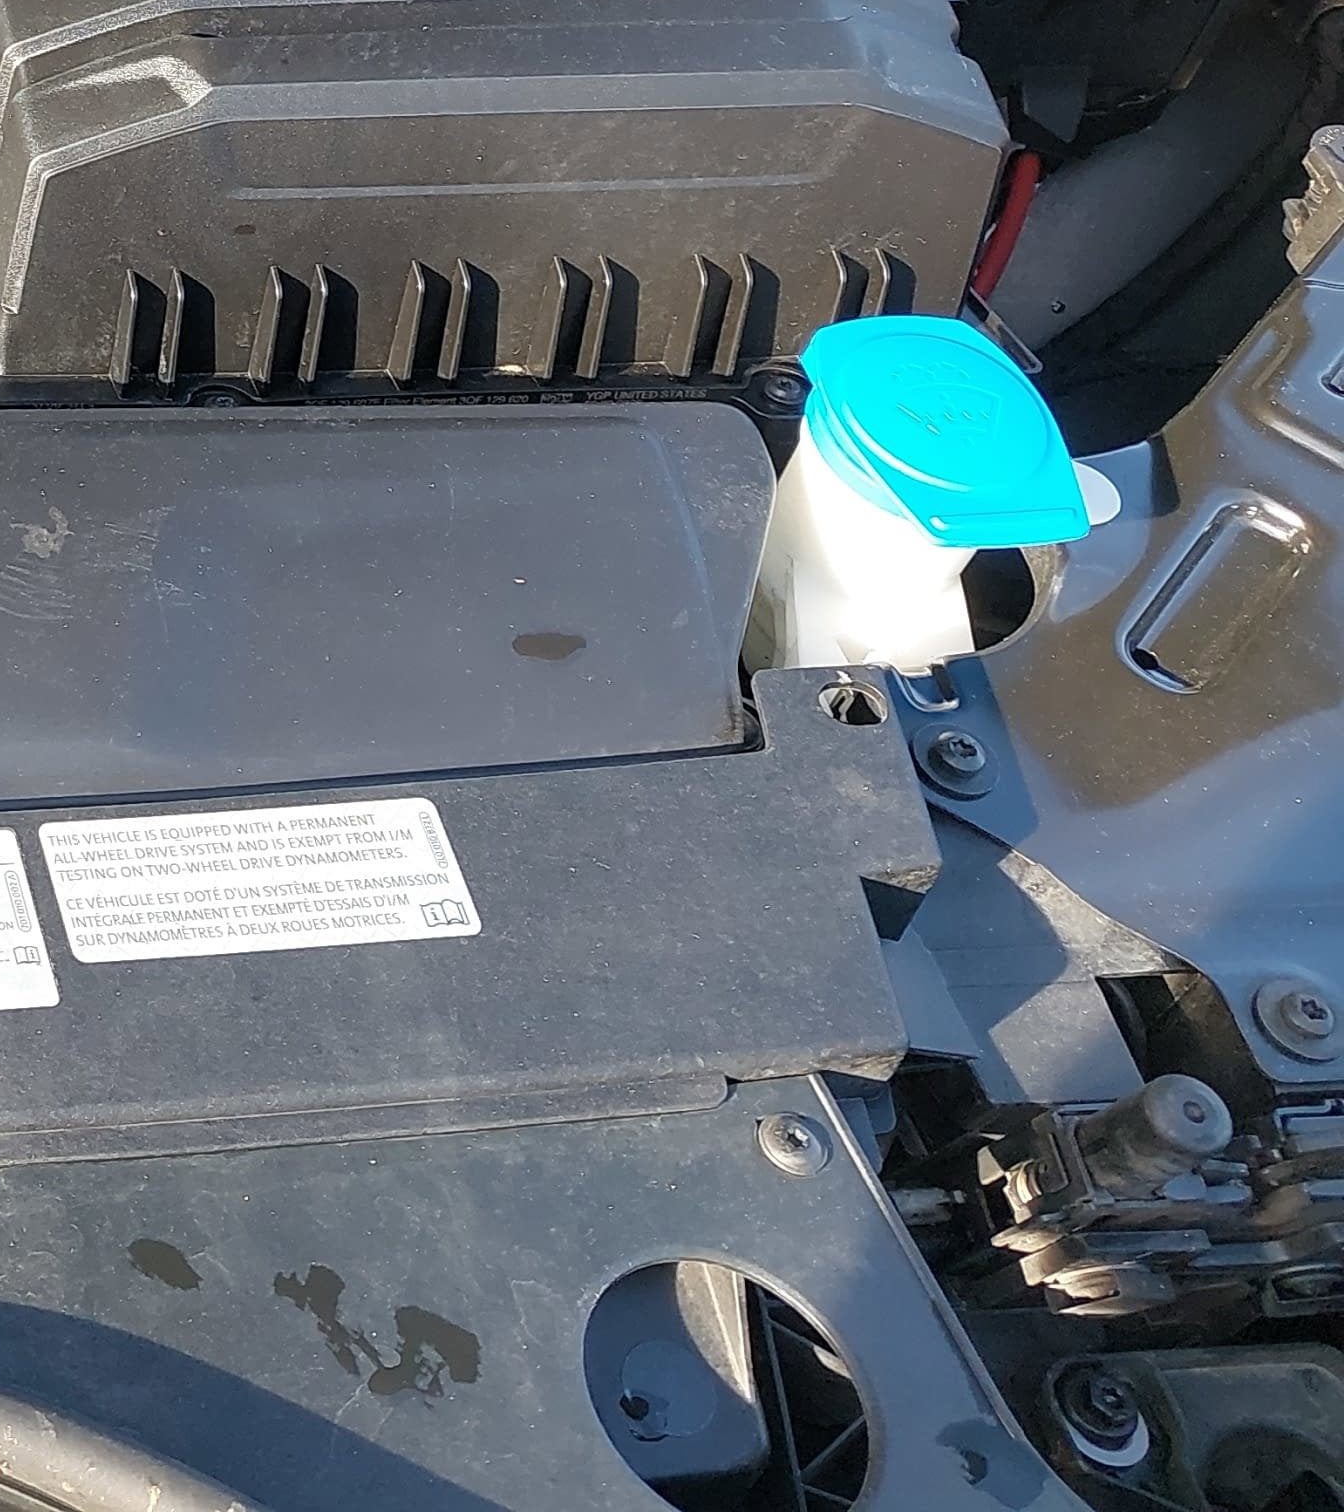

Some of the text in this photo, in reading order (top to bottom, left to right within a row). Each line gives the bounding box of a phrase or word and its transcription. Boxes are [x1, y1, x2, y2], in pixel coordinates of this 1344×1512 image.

[48, 814, 376, 847] THIS VEHICLE IS EQUIPPED WITH A PERMANENT
[54, 829, 413, 864] ALL-WHEEL DRIVE SYSTEM AND IS EXEMPT FROM I/M
[56, 847, 408, 882] TESTING ON TWO-WHEEL DRIVE DYNAMOMETERS.
[66, 873, 450, 910] CE VÉHICULE EST DOTÉ D'UN SYSTÈME DE TRANSMISSION
[71, 912, 146, 929] INTÉGRALE
[147, 906, 230, 924] PERMANENT
[233, 906, 249, 918] ET
[252, 898, 312, 915] EXEMPTÉ
[313, 896, 372, 912] D'ESSAIS
[75, 913, 406, 947] SUR DYNAMOMÈTRES À DEUX ROUES MOTRICES.
